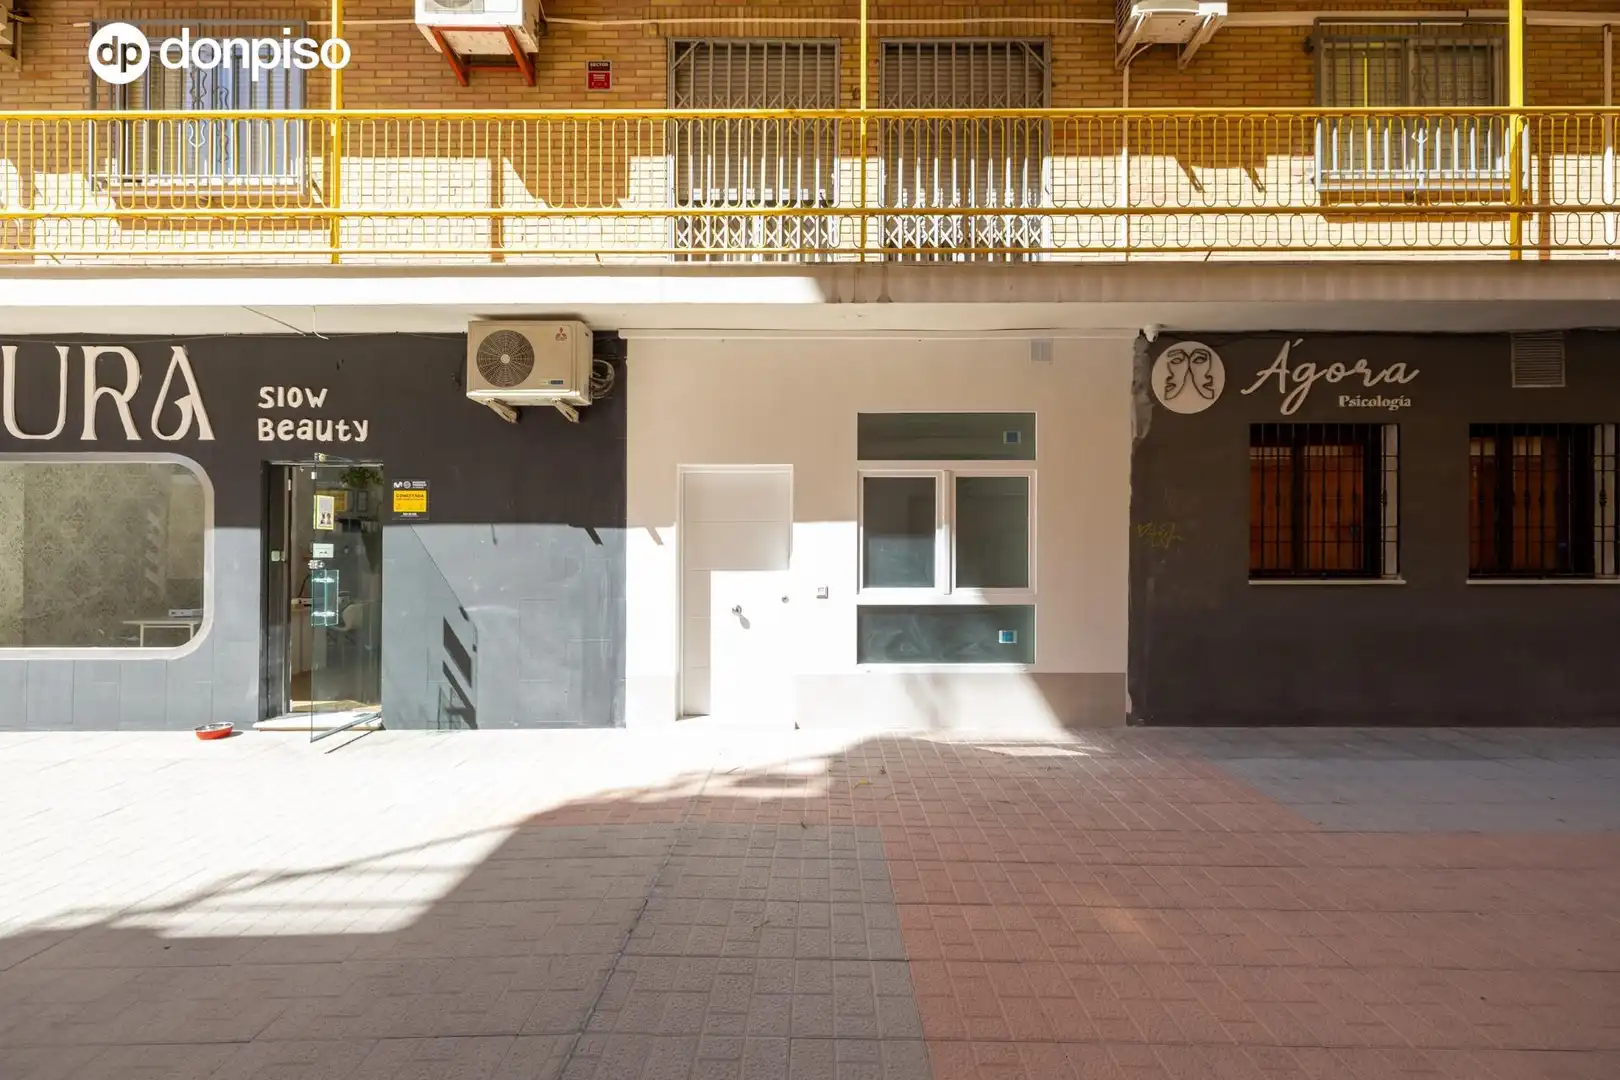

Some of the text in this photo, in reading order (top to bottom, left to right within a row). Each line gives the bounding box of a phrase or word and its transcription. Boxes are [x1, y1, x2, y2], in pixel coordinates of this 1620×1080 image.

[1, 345, 216, 441] URA
[1240, 338, 1420, 416] Ágora
[1338, 394, 1412, 411] Psicología
[257, 417, 369, 442] Beauty
